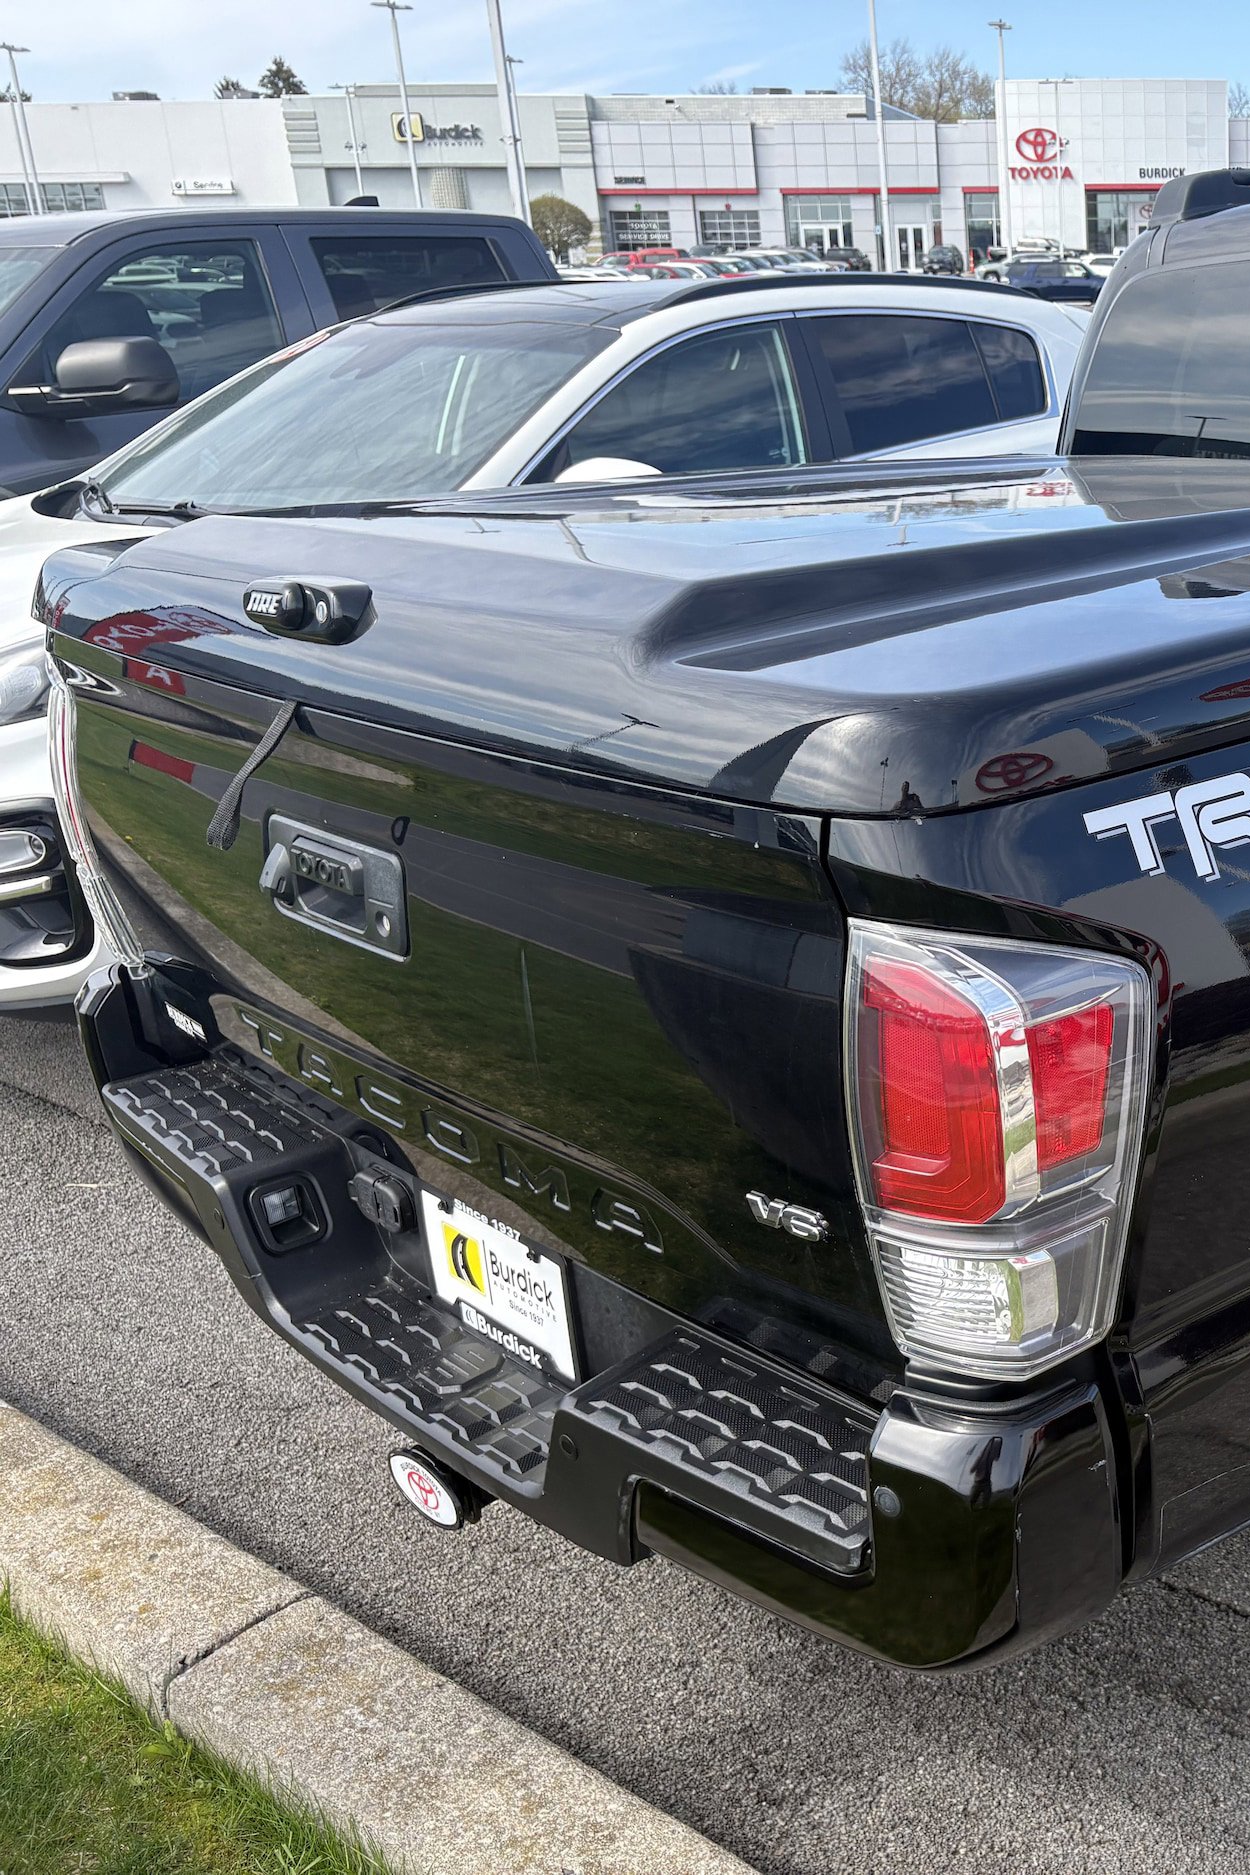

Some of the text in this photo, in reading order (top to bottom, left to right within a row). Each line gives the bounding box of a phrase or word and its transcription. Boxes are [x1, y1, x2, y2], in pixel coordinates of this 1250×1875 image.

[424, 123, 483, 140] Burdick
[1008, 166, 1074, 181] TOYOTA
[1139, 167, 1186, 179] BURDICK
[237, 1005, 665, 1255] TACOMA
[454, 1198, 521, 1242] Since 1937
[745, 1189, 828, 1243] V6
[489, 1249, 555, 1311] Burdick
[493, 1279, 558, 1323] AUTOMOTIVE
[508, 1299, 545, 1327] Since 1937
[476, 1313, 543, 1369] Burdick
